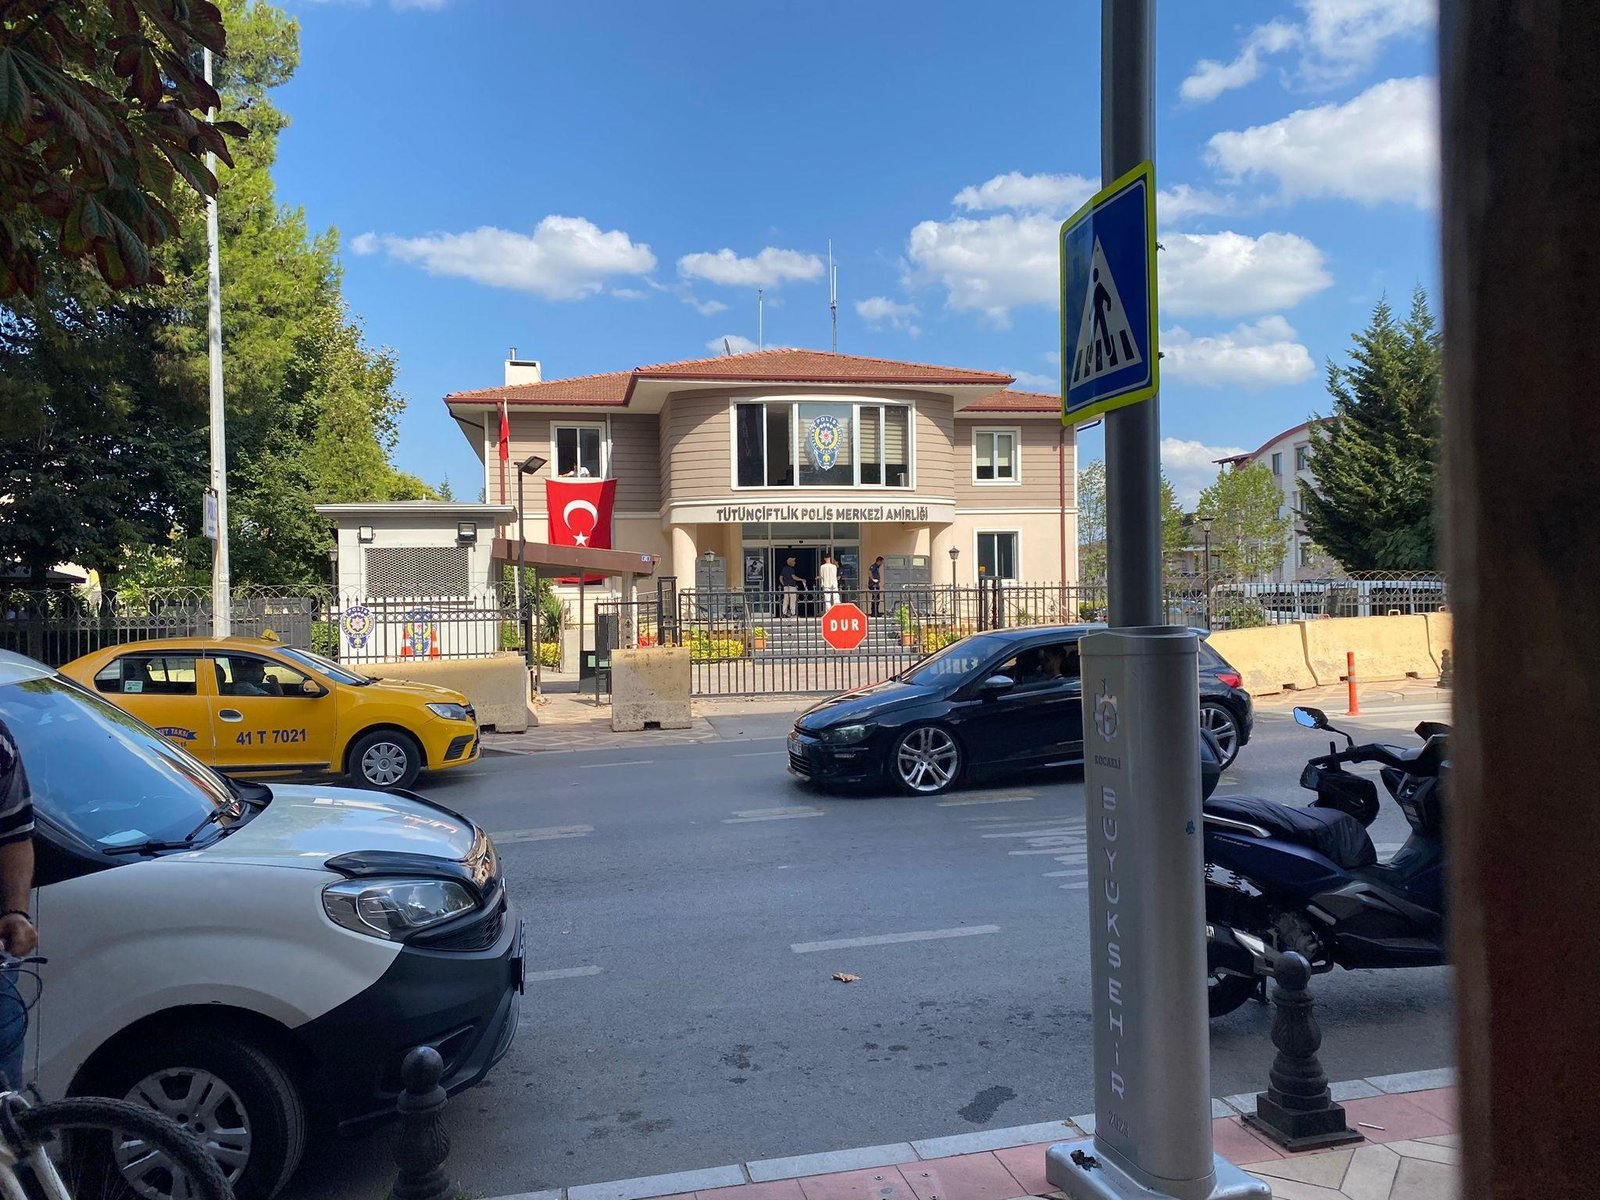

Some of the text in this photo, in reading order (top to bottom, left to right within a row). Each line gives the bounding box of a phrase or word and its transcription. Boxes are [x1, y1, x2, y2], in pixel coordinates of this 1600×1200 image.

[716, 505, 928, 522] TÜTÜNÇİFTLİK POLİS MERKEZİ AMİRLİĞİ
[830, 618, 860, 632] DUR
[236, 728, 306, 745] 41 T 7021
